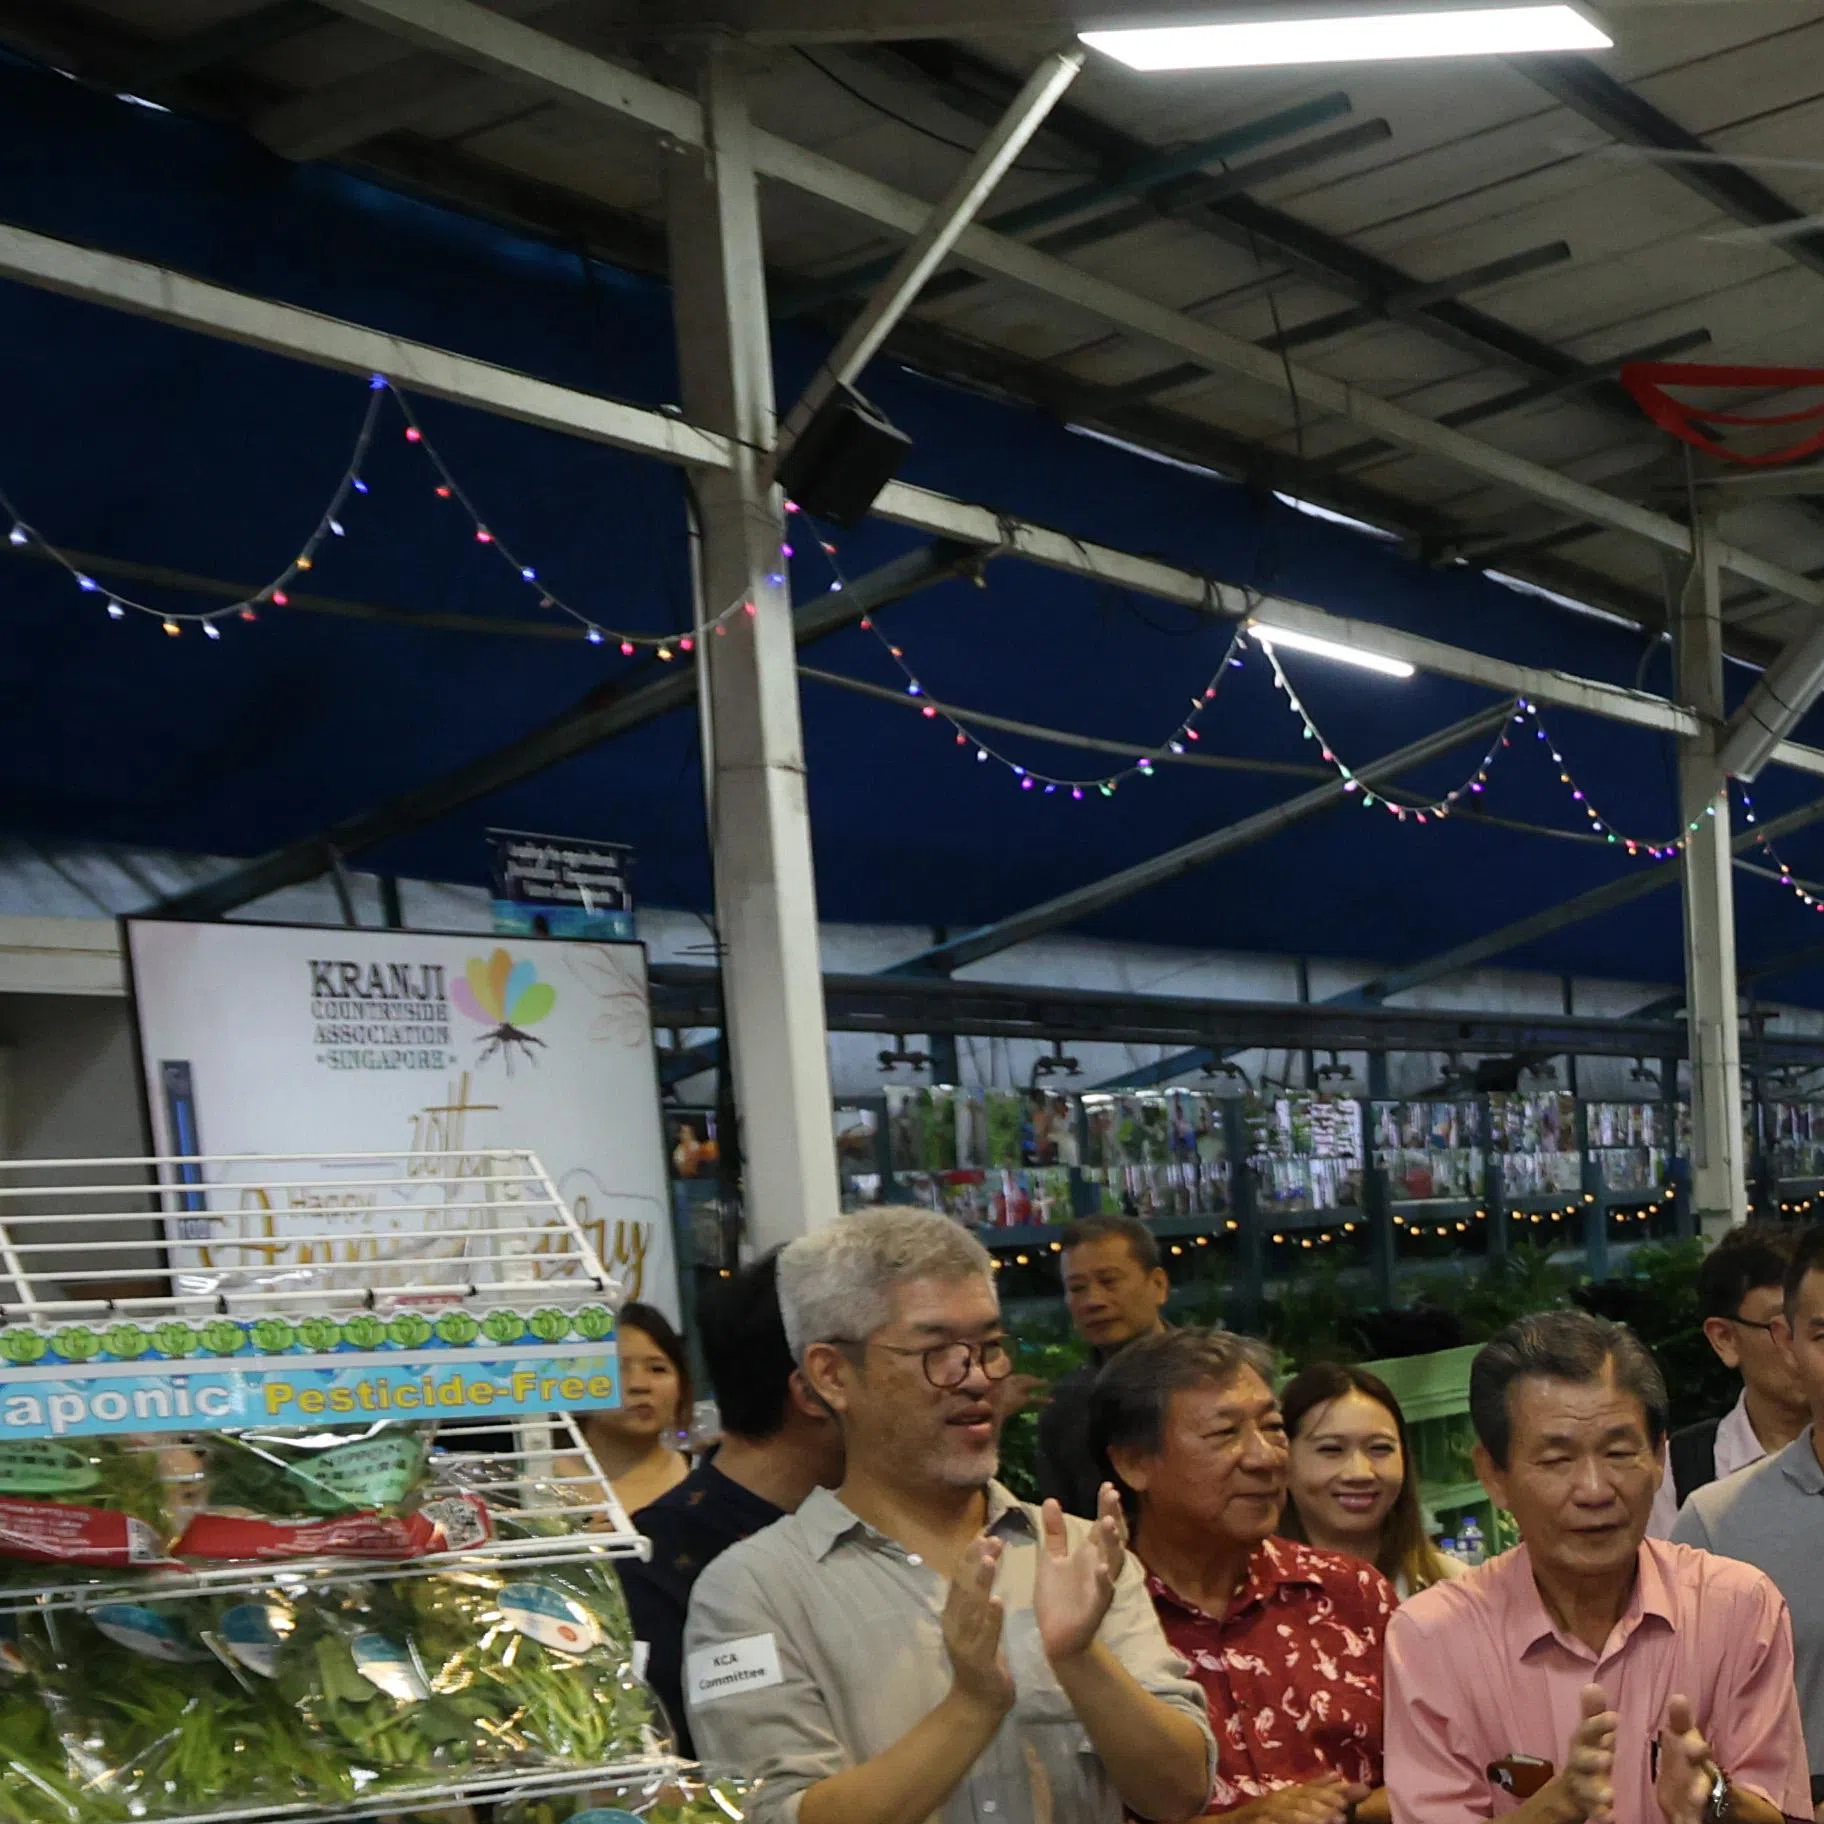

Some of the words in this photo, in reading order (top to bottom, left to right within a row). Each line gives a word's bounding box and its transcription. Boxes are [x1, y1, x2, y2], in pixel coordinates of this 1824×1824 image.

[308, 960, 447, 1000] KRANJI
[311, 1001, 449, 1021] COUNTRYSIDE
[313, 1025, 450, 1045] ASSOCIATION
[264, 1371, 612, 1415] Pesticide-Free
[713, 1653, 738, 1667] KCA
[699, 1668, 765, 1690] Committee
